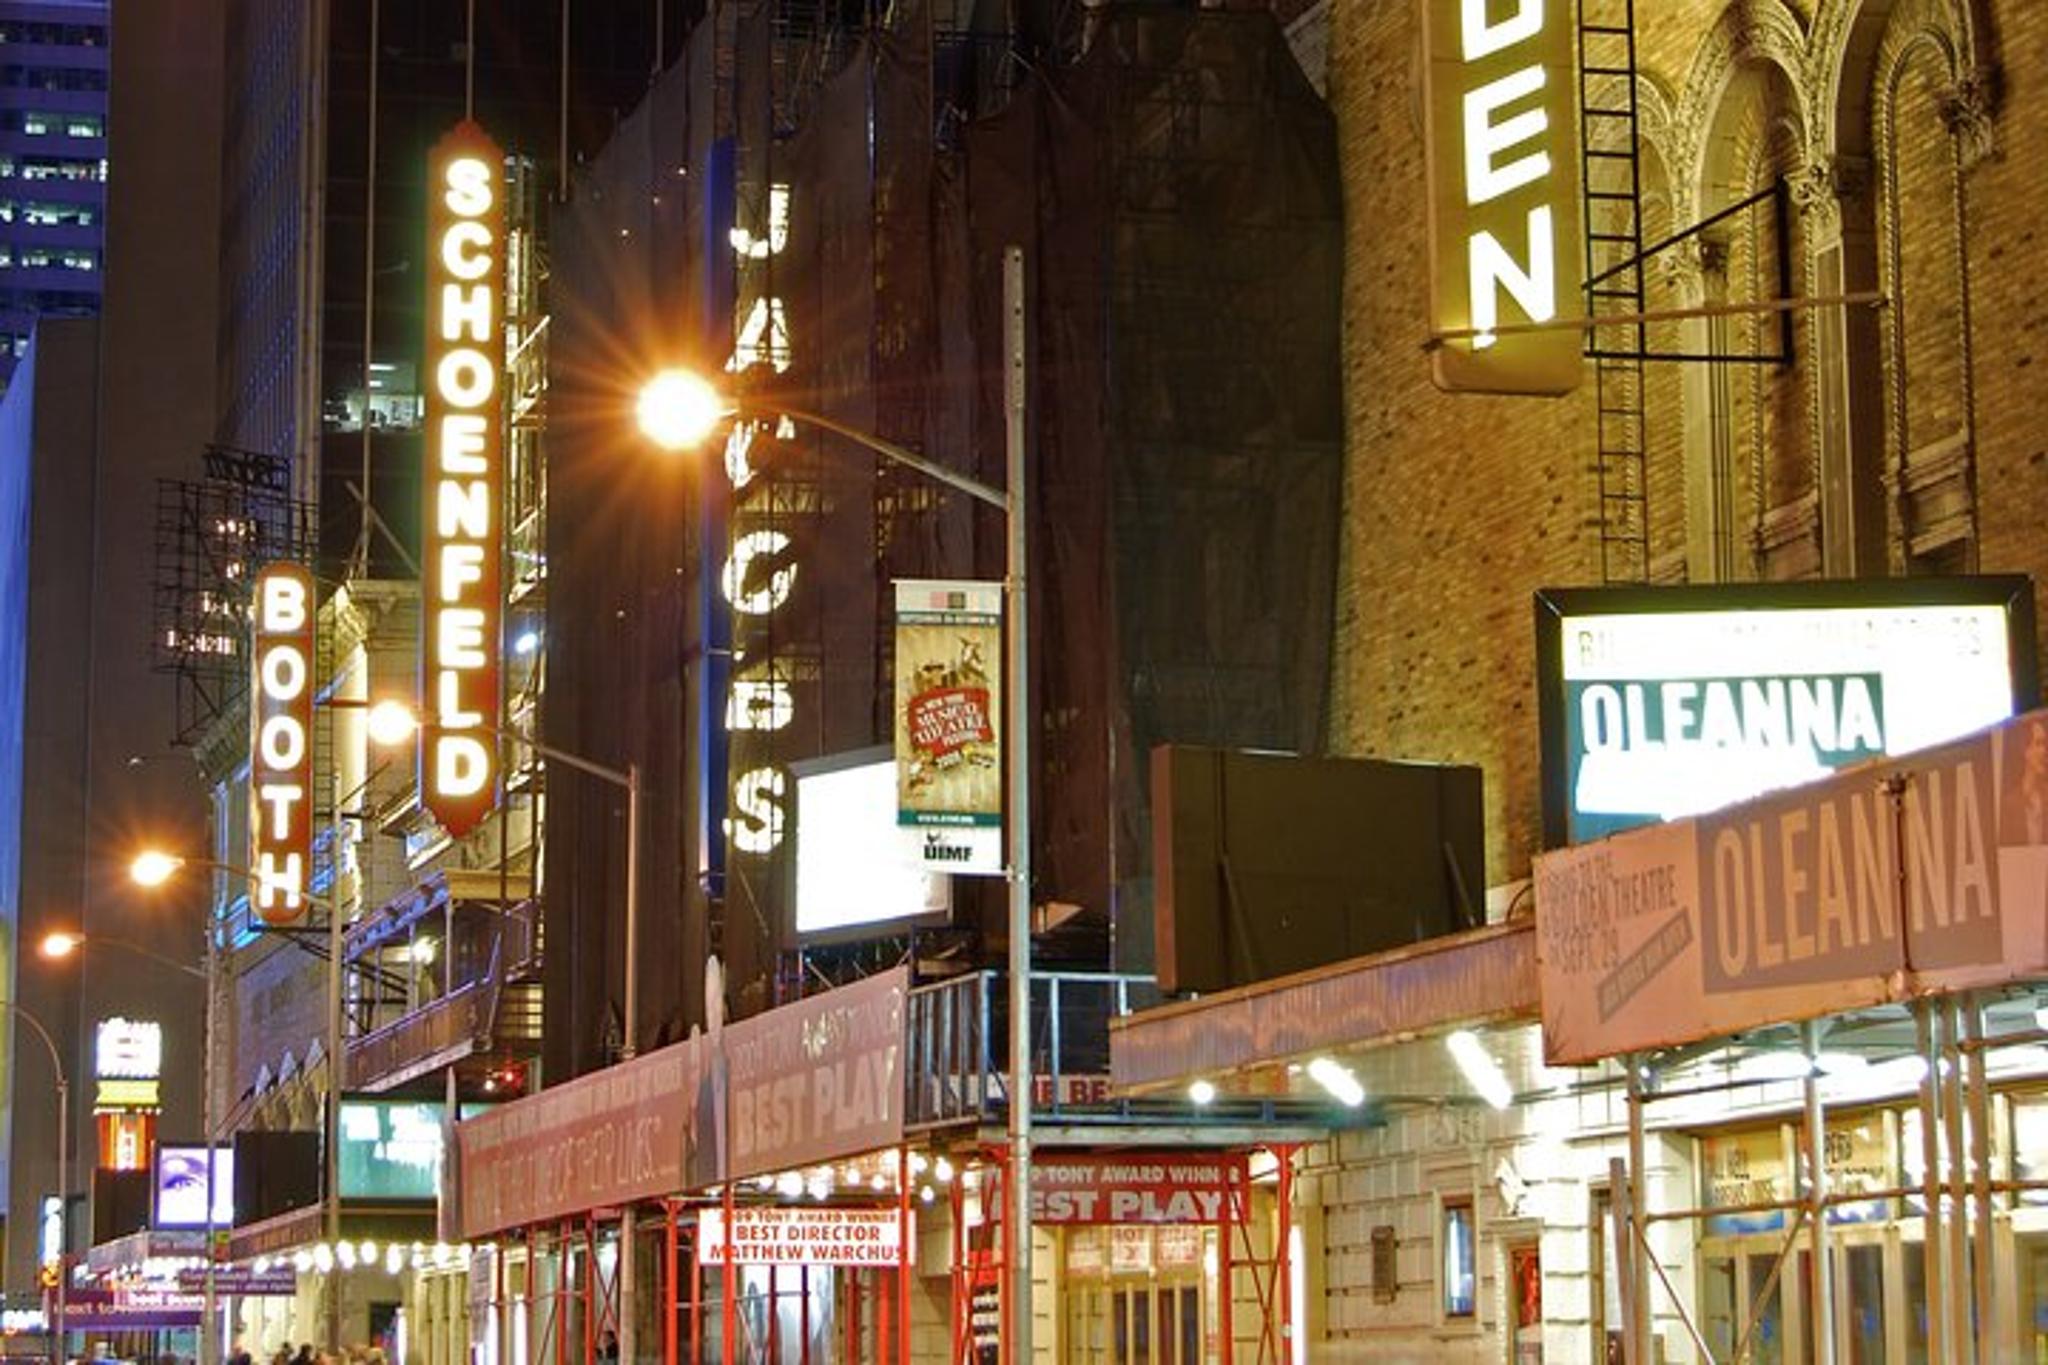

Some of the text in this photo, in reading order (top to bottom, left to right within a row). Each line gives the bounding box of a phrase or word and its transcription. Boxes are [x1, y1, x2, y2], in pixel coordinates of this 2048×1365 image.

[436, 157, 496, 797] SCHOENFELD
[257, 576, 306, 909] BOOTH
[1580, 677, 1886, 755] OLEANNA
[1713, 759, 1994, 979] OLEANNA
[734, 1072, 808, 1158] BEST
[812, 1044, 898, 1139] PLAY
[1046, 1165, 1094, 1184] TONY
[1100, 1164, 1164, 1184] AWARD
[1168, 1164, 1240, 1184] WINNR
[735, 1224, 881, 1242] BEST DIRECTOR
